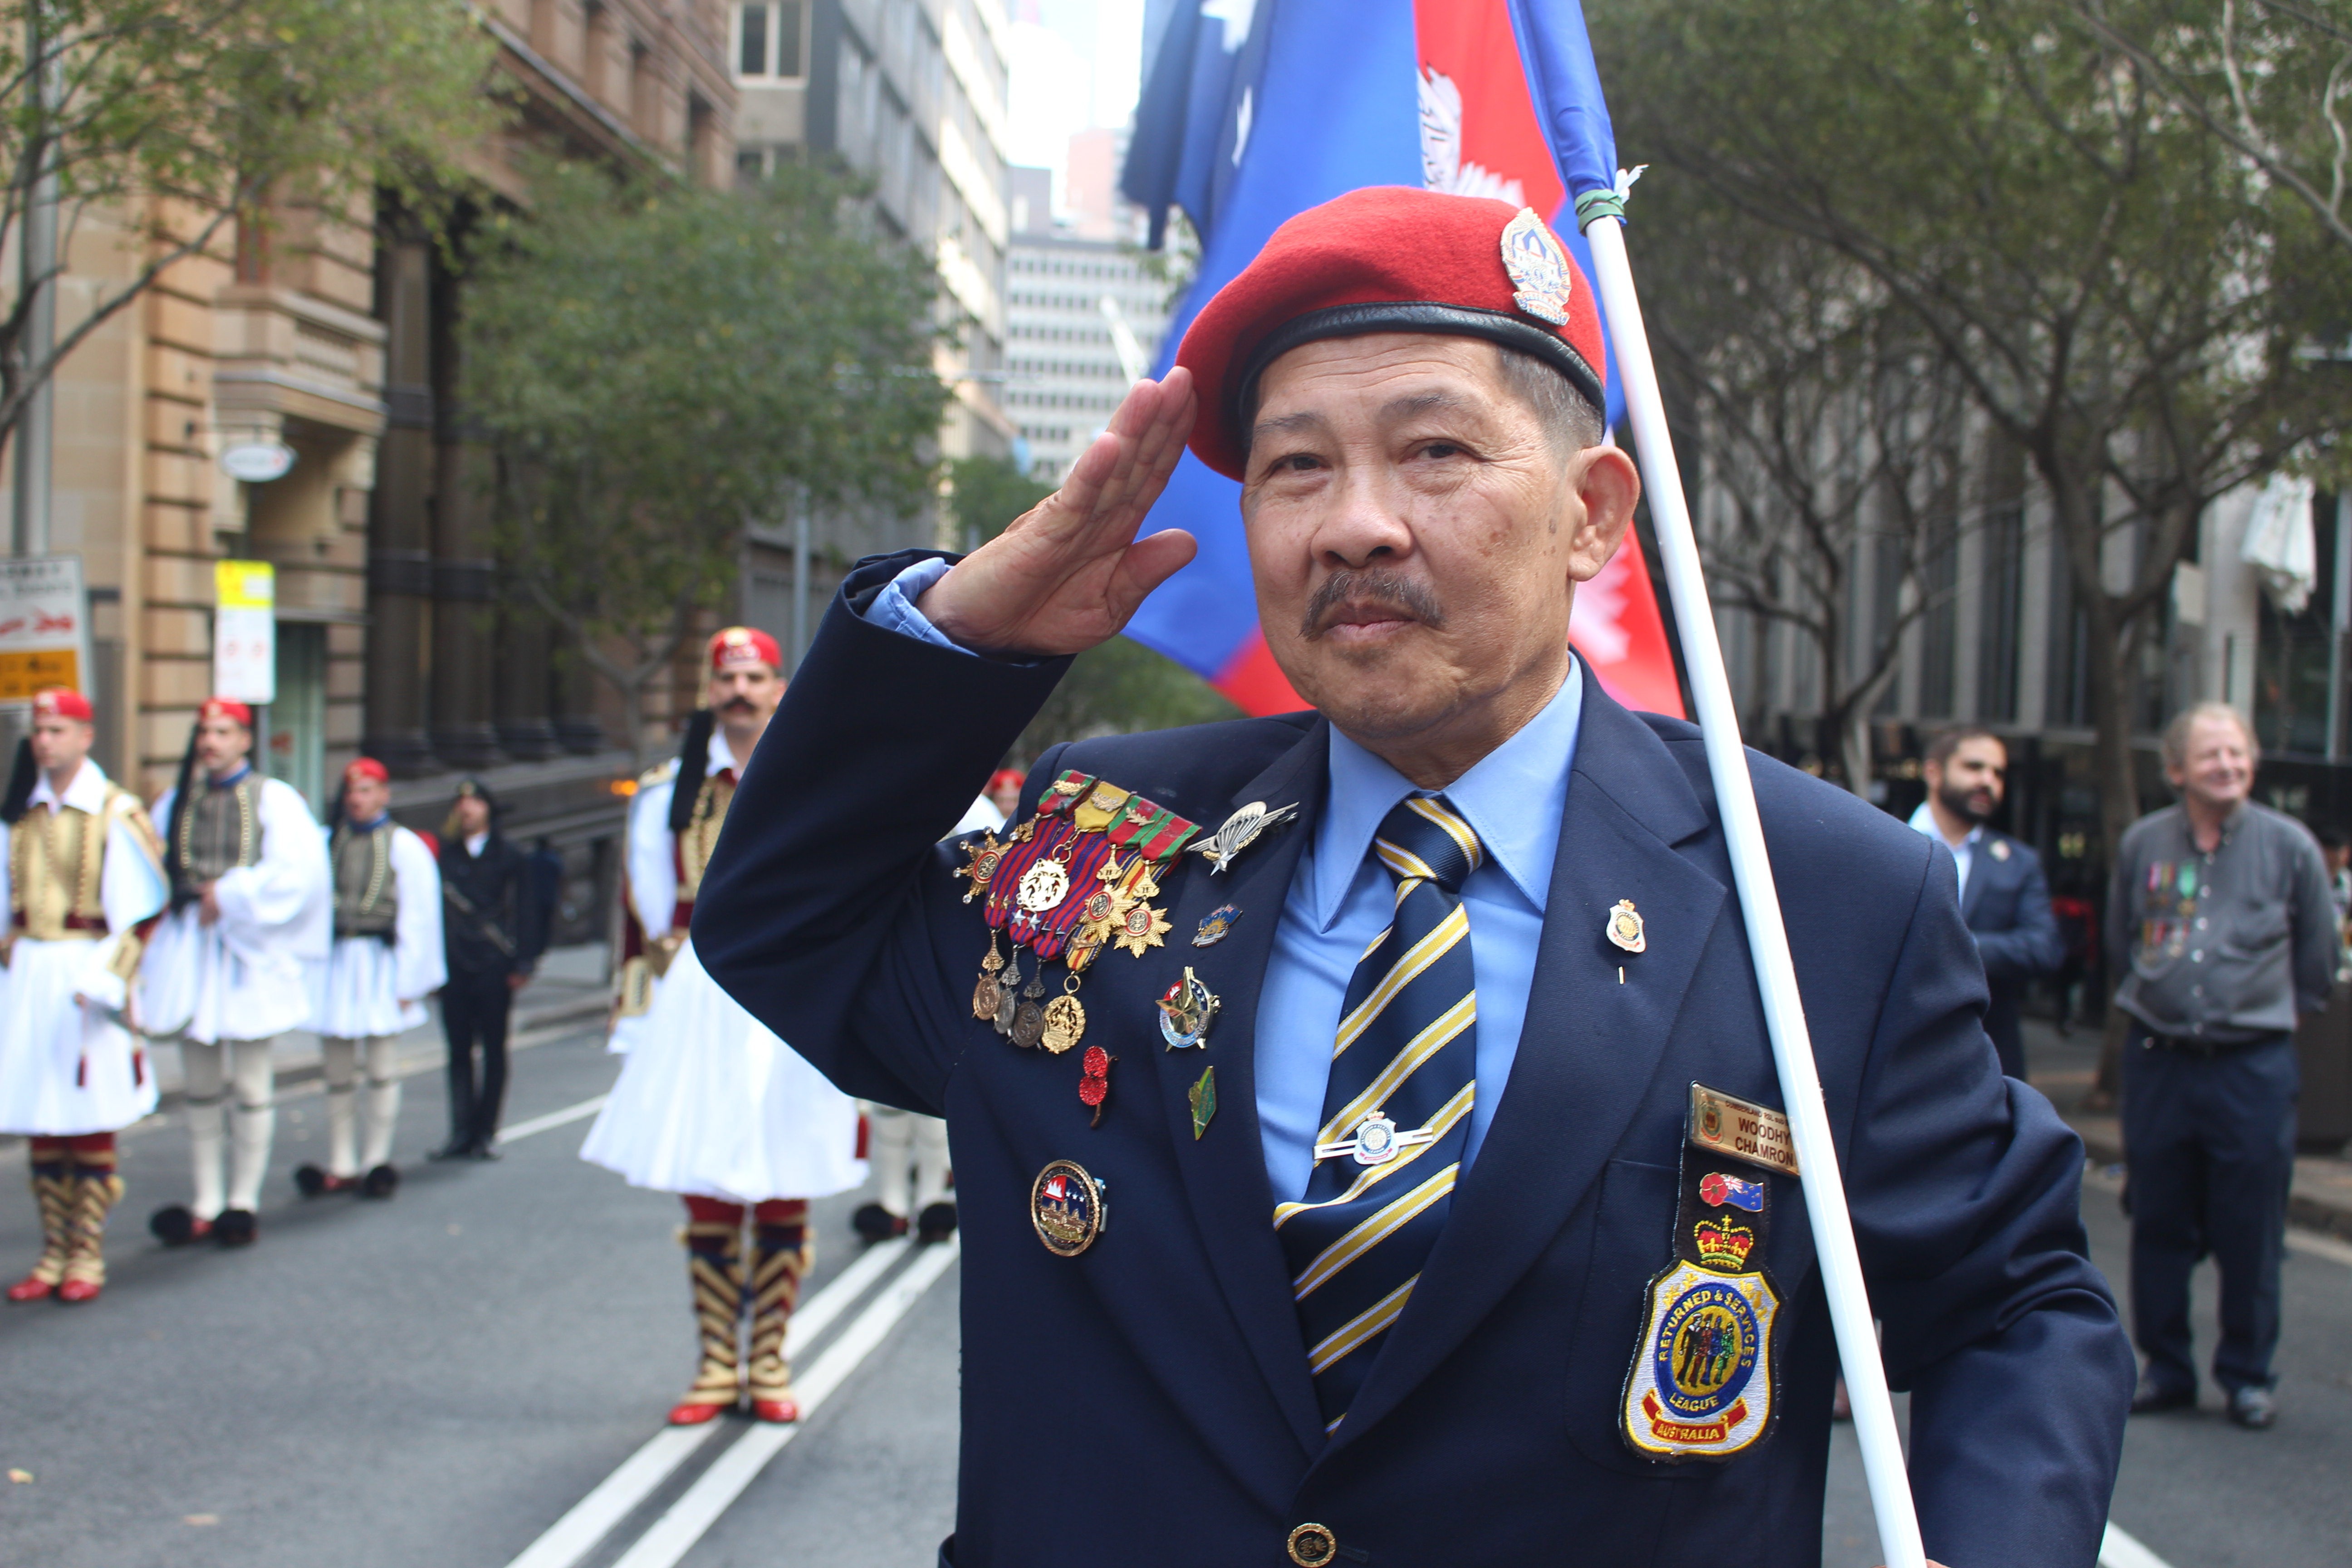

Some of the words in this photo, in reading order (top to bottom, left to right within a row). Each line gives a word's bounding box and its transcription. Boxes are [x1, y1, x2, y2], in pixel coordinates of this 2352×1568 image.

[1738, 1117, 1790, 1146] WOODHY
[1735, 1137, 1793, 1166] CHAMRON
[1658, 1290, 1711, 1361] RETURNED
[1714, 1289, 1723, 1302] &
[1725, 1292, 1755, 1367] SERVICES
[1669, 1392, 1719, 1412] LEAGUE
[1657, 1423, 1720, 1439] AUSTRALIA
